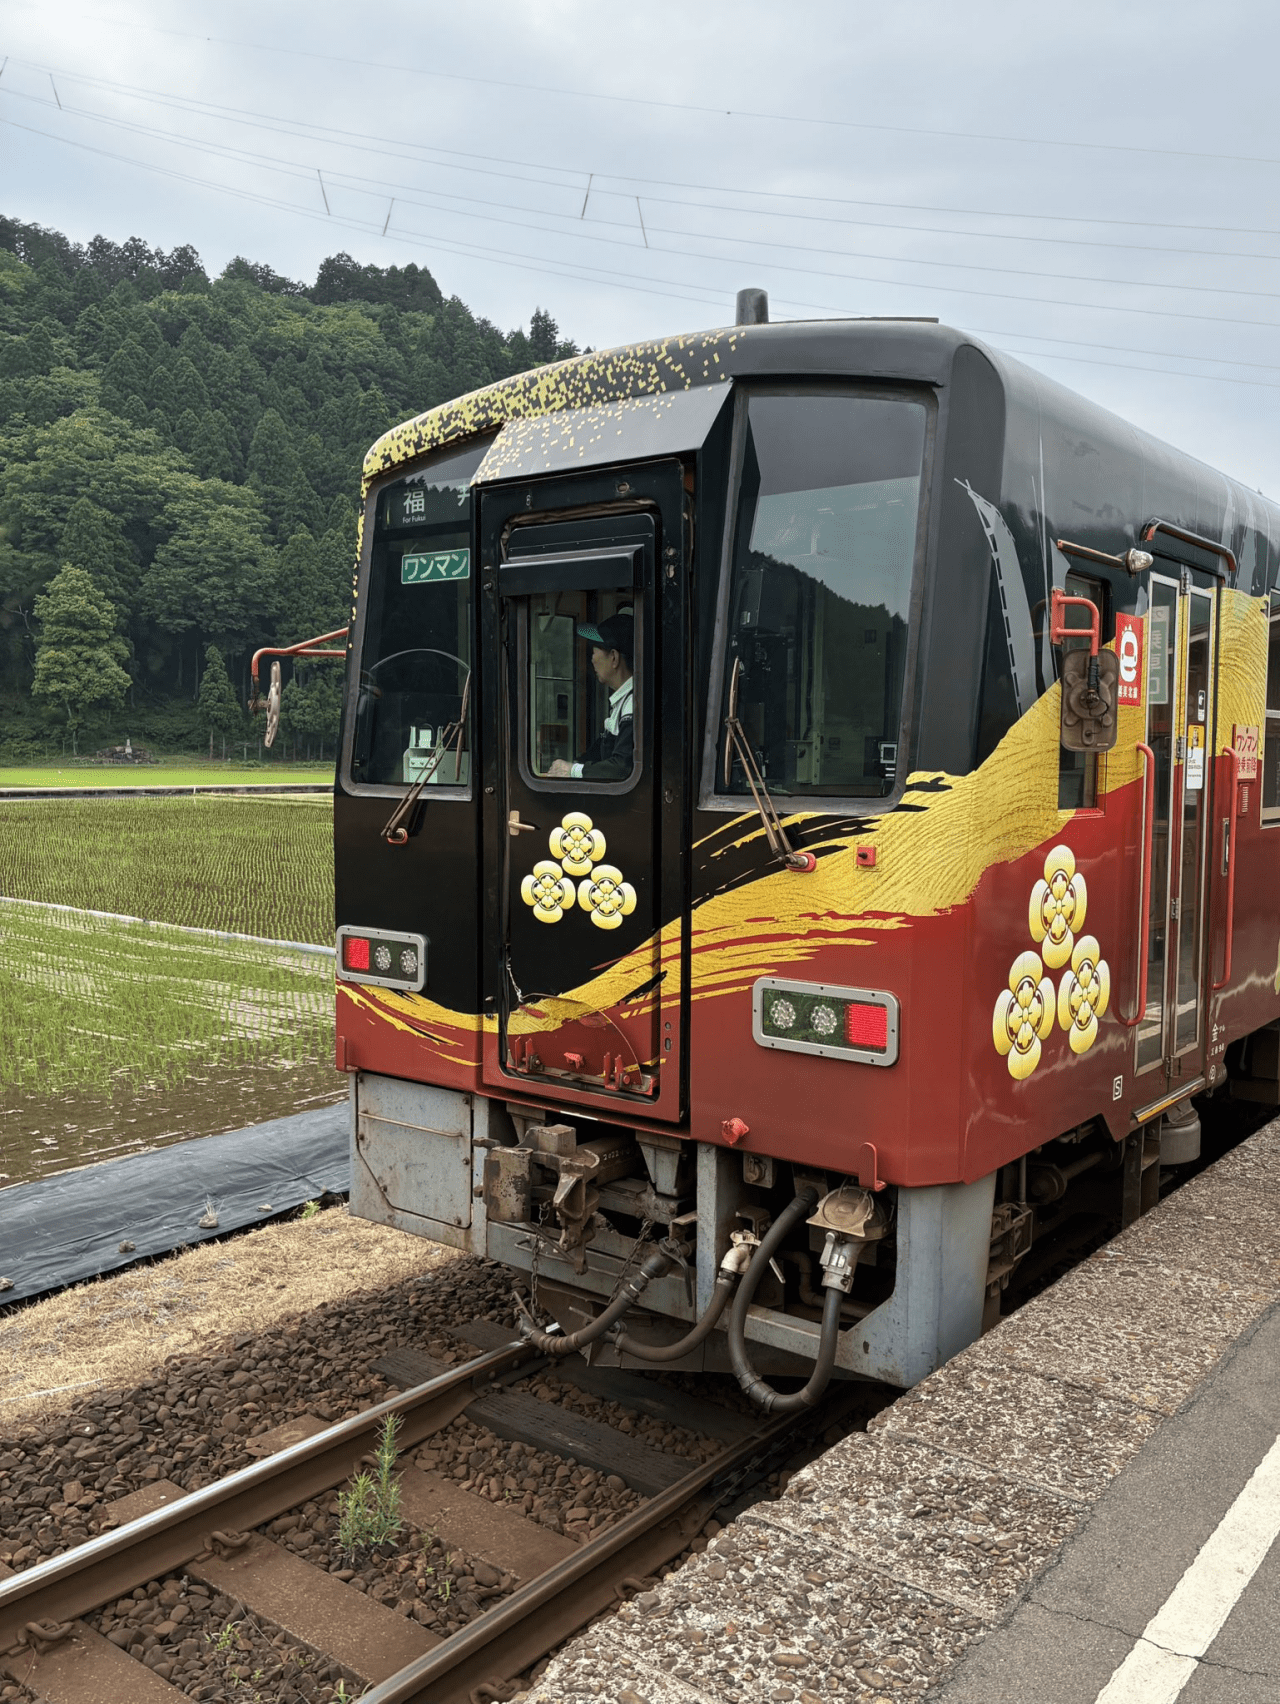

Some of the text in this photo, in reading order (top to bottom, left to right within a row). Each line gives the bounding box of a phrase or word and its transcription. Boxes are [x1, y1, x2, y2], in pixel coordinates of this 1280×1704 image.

[402, 515, 426, 524] For Fukui
[404, 553, 467, 580] ワンマン
[1236, 735, 1258, 752] ワンマン
